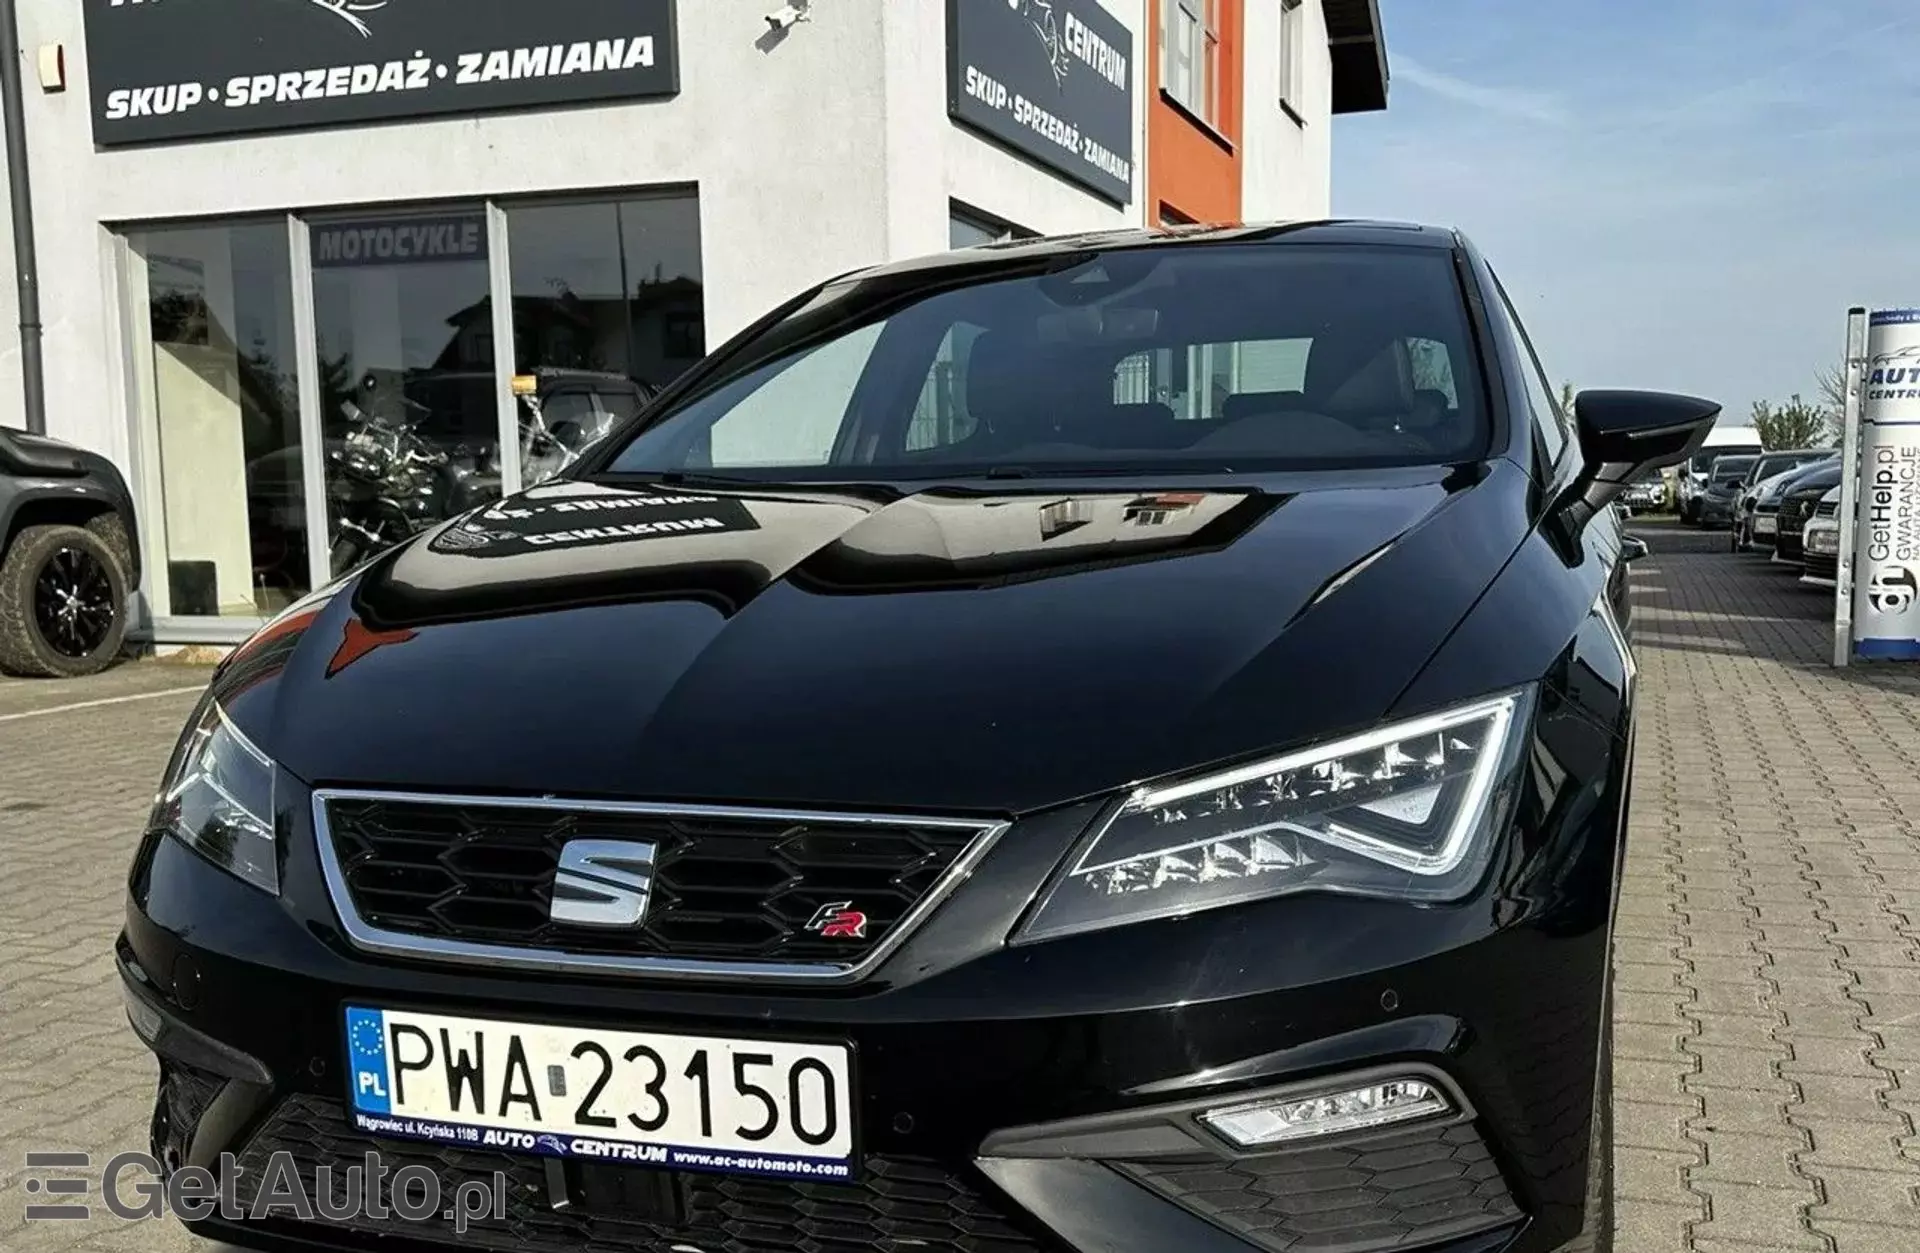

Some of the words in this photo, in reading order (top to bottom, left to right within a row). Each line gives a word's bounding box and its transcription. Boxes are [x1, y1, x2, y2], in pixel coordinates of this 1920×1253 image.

[105, 80, 203, 119] SKUP
[225, 50, 429, 108] SPRZEDAŻ
[456, 36, 654, 84] ZAMIANA
[1065, 12, 1126, 91] CENTRUM
[965, 65, 1007, 110] SKUP
[1013, 94, 1079, 154] SPRZEDAŻ
[1084, 137, 1129, 184] ZAMIANA
[318, 223, 478, 261] MOTOCYKLE
[1869, 389, 1920, 400] CENTR
[1868, 445, 1899, 562] GetHelp.pl
[1896, 446, 1917, 561] GWARANCJE
[804, 900, 867, 938] FR
[359, 1072, 387, 1097] PL
[389, 1022, 542, 1121] PWA
[570, 1041, 837, 1146] 23150
[483, 1130, 536, 1149] AUTO
[570, 1139, 668, 1163] CENTRUM
[673, 1150, 849, 1177] www.ac-automoto.com
